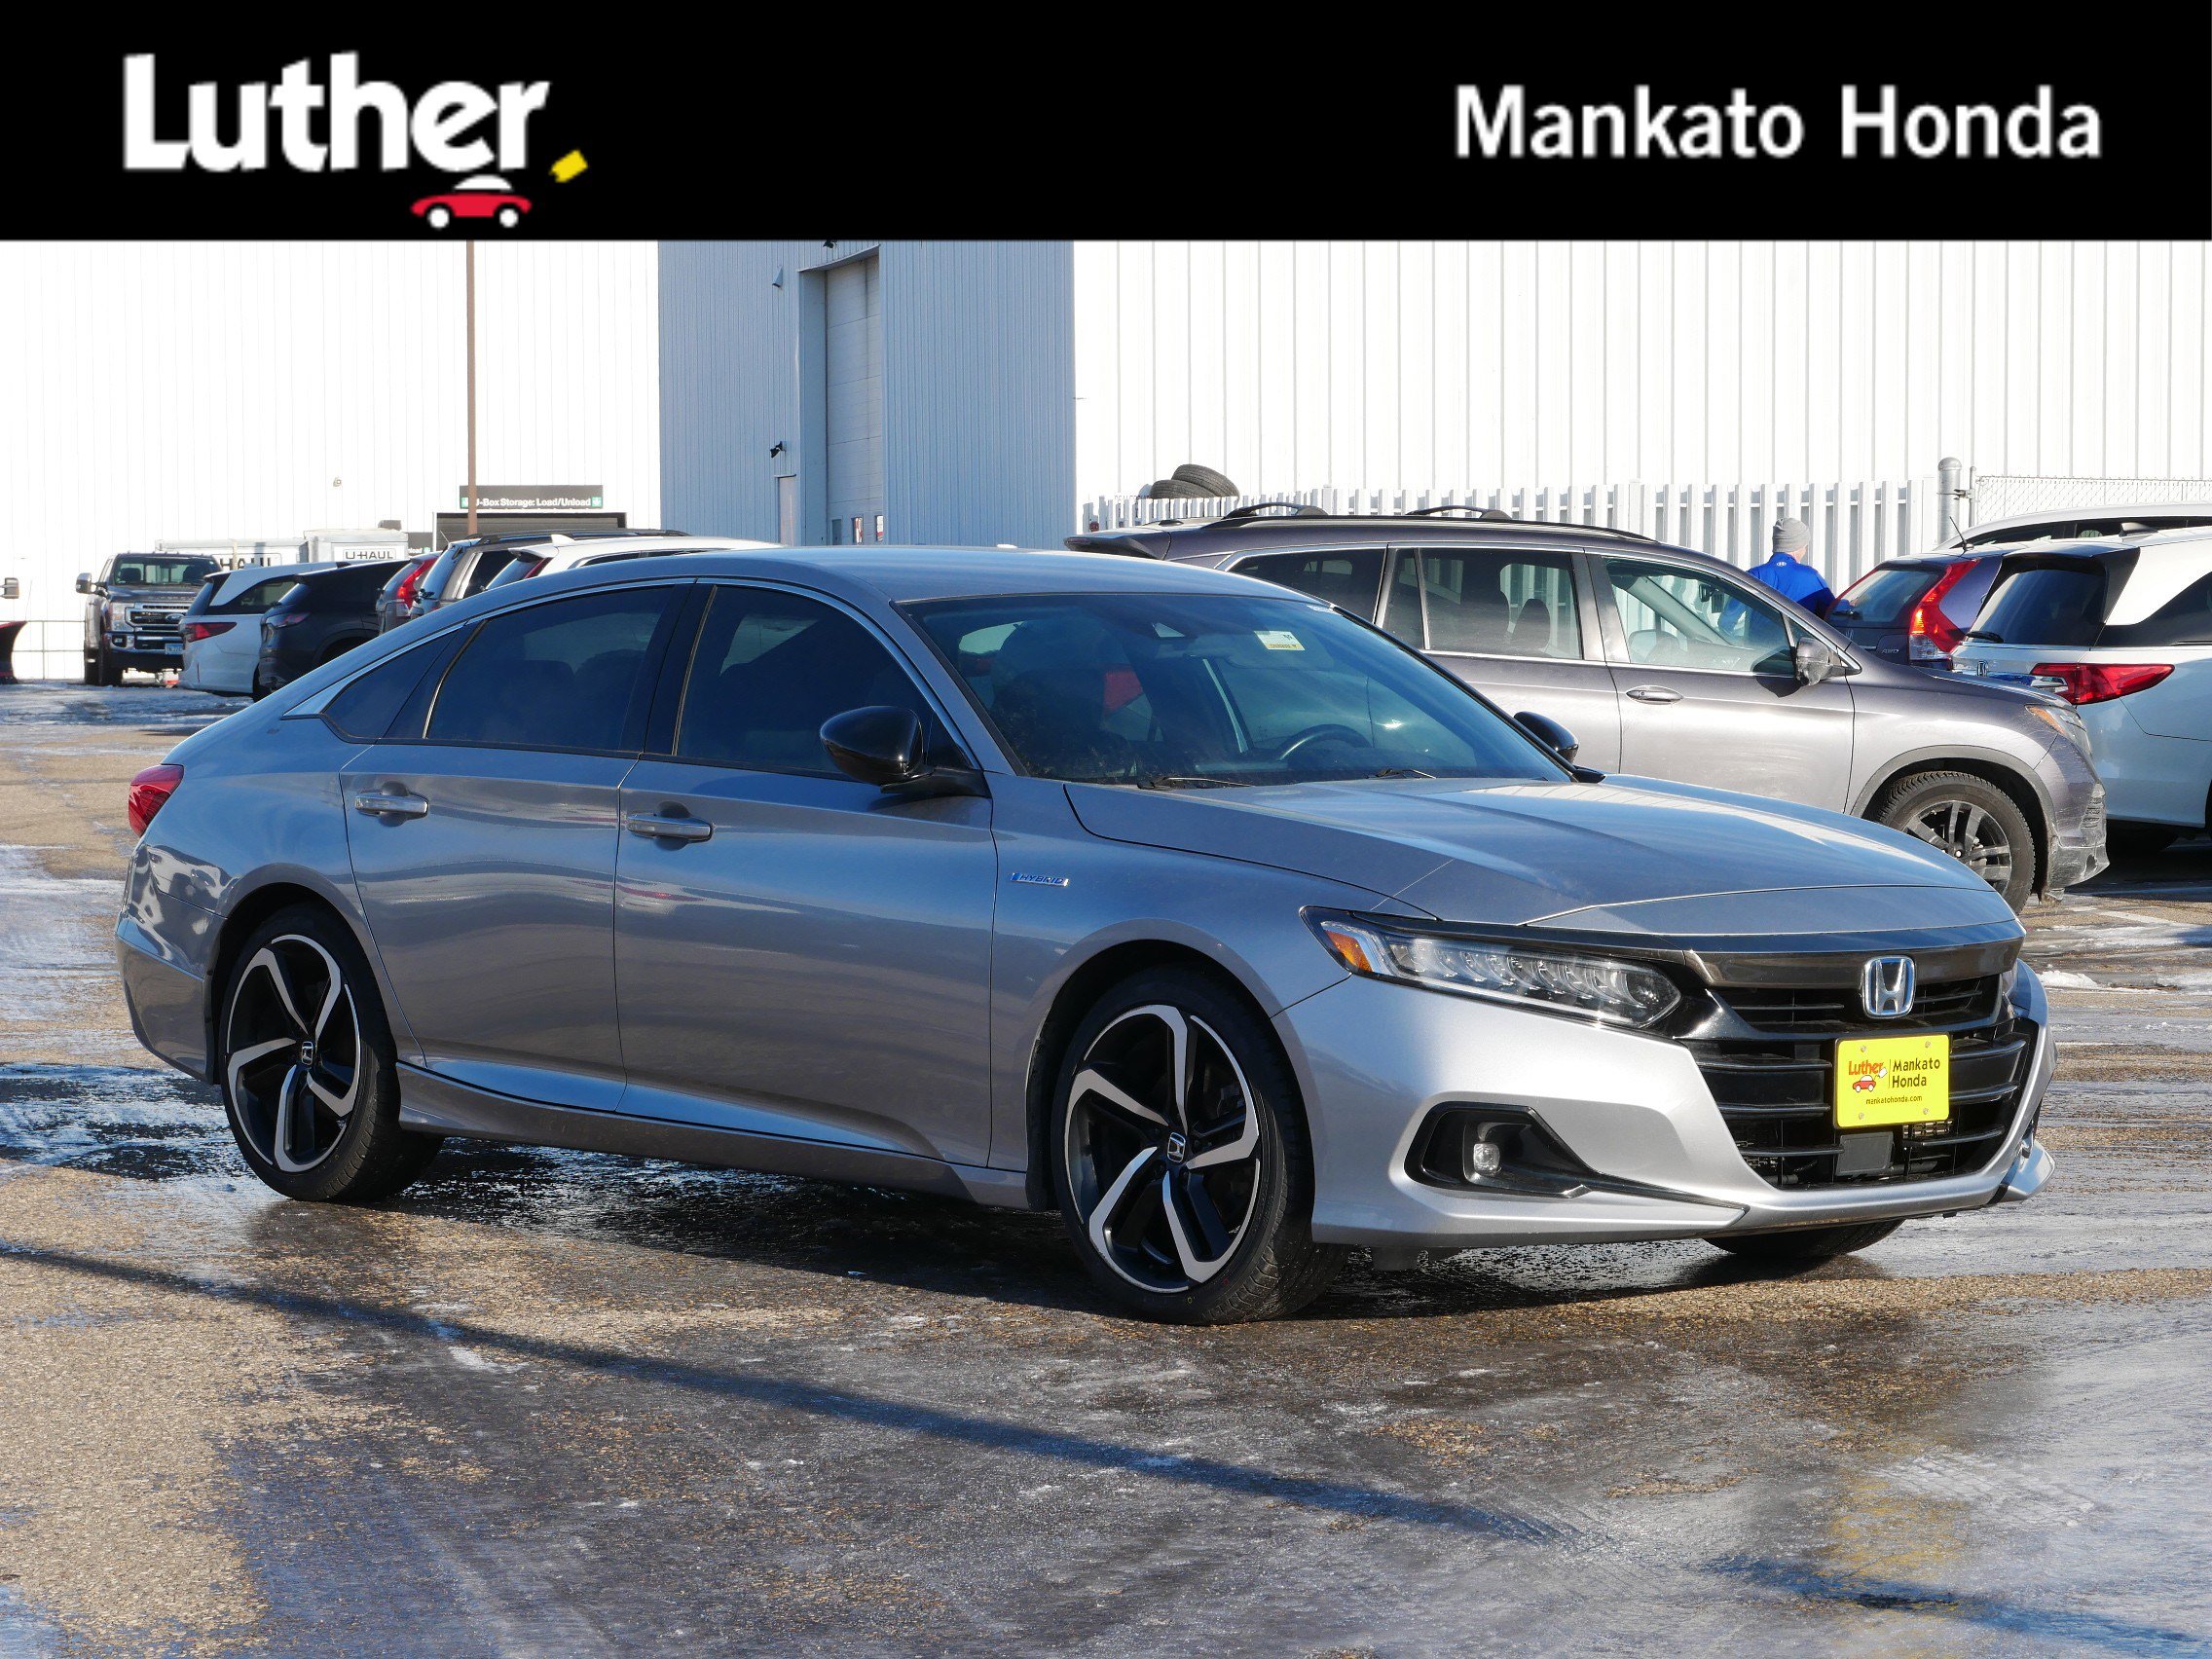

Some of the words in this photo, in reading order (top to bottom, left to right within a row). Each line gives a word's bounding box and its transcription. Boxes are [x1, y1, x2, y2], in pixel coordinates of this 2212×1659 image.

[500, 498, 535, 508] Storage:
[535, 498, 591, 507] Load/Unload
[1019, 874, 1063, 884] HYBRID
[1848, 1059, 1884, 1076] Luther
[1893, 1057, 1940, 1073] Mankato
[1892, 1074, 1928, 1088] Honda
[1865, 1094, 1923, 1105] mankatohonda.com
